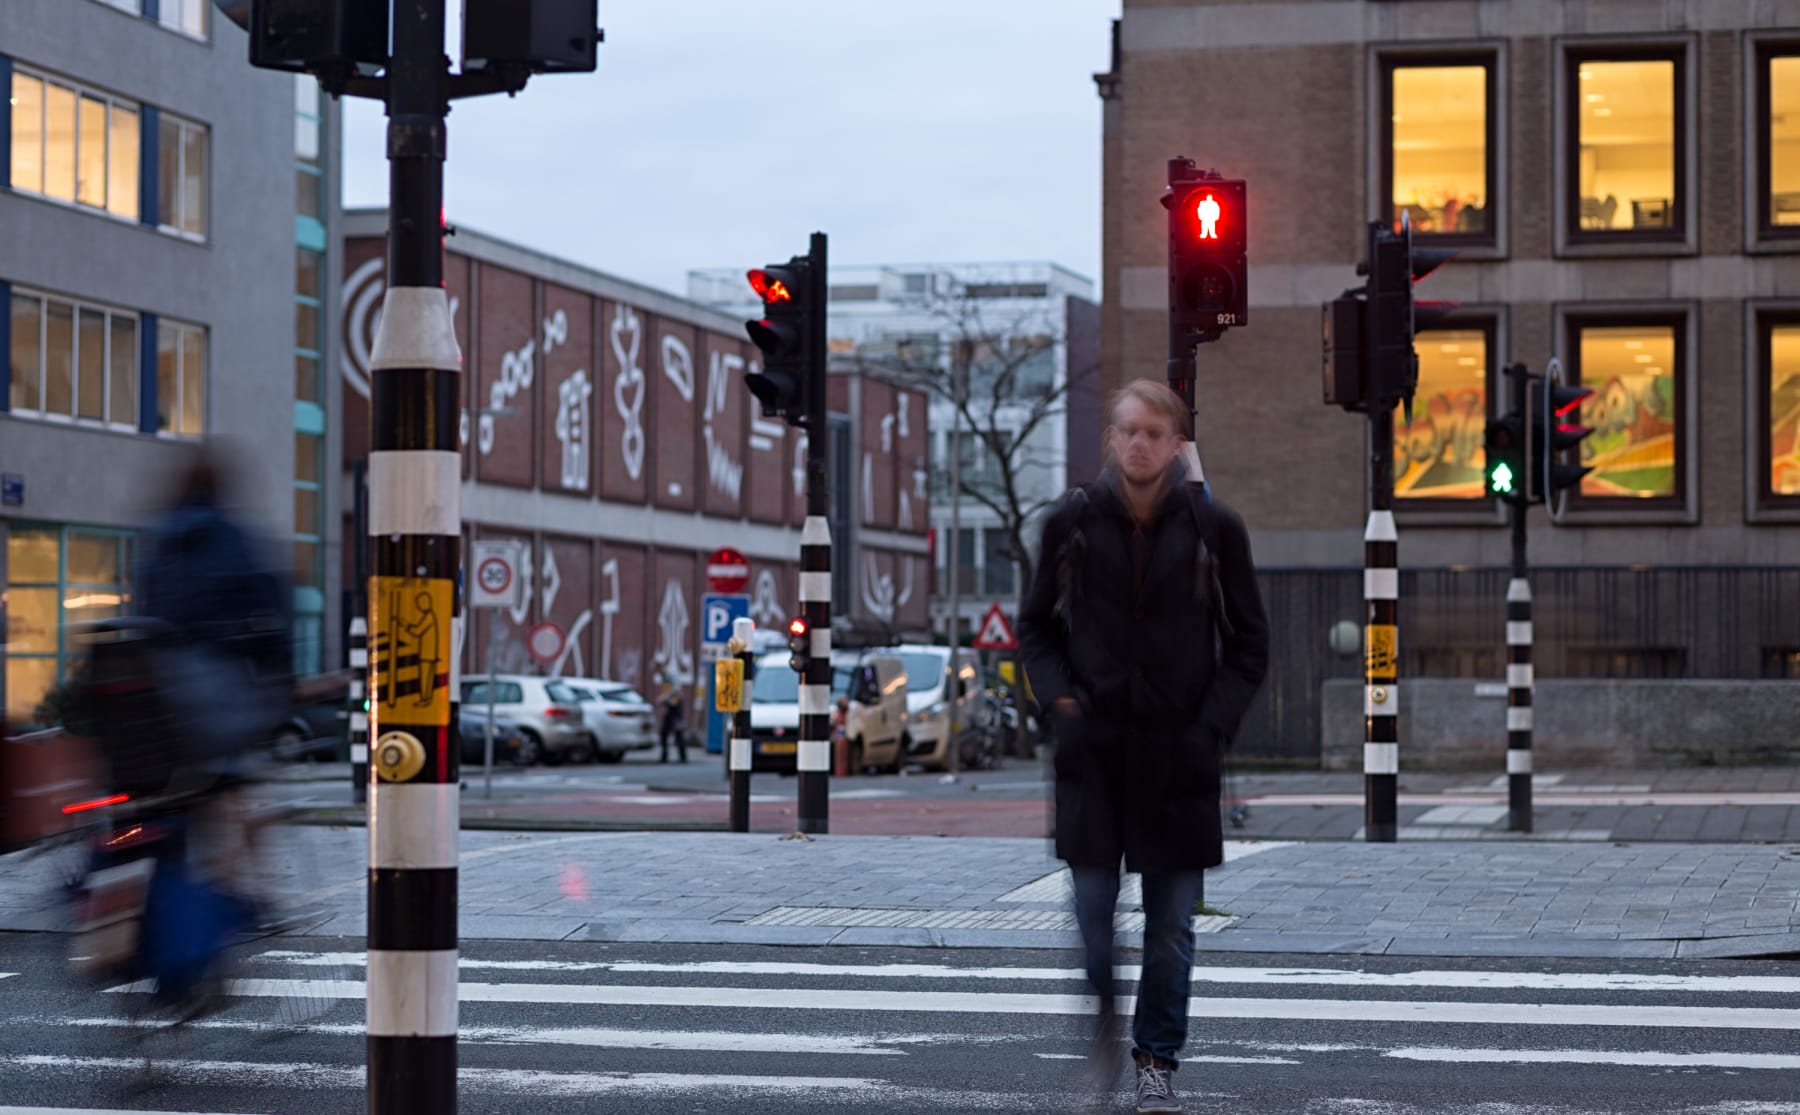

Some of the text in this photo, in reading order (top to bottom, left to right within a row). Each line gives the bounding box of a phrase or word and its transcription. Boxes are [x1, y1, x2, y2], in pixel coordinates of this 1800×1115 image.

[1217, 313, 1236, 325] 921
[485, 568, 504, 583] 30
[708, 607, 730, 640] P
